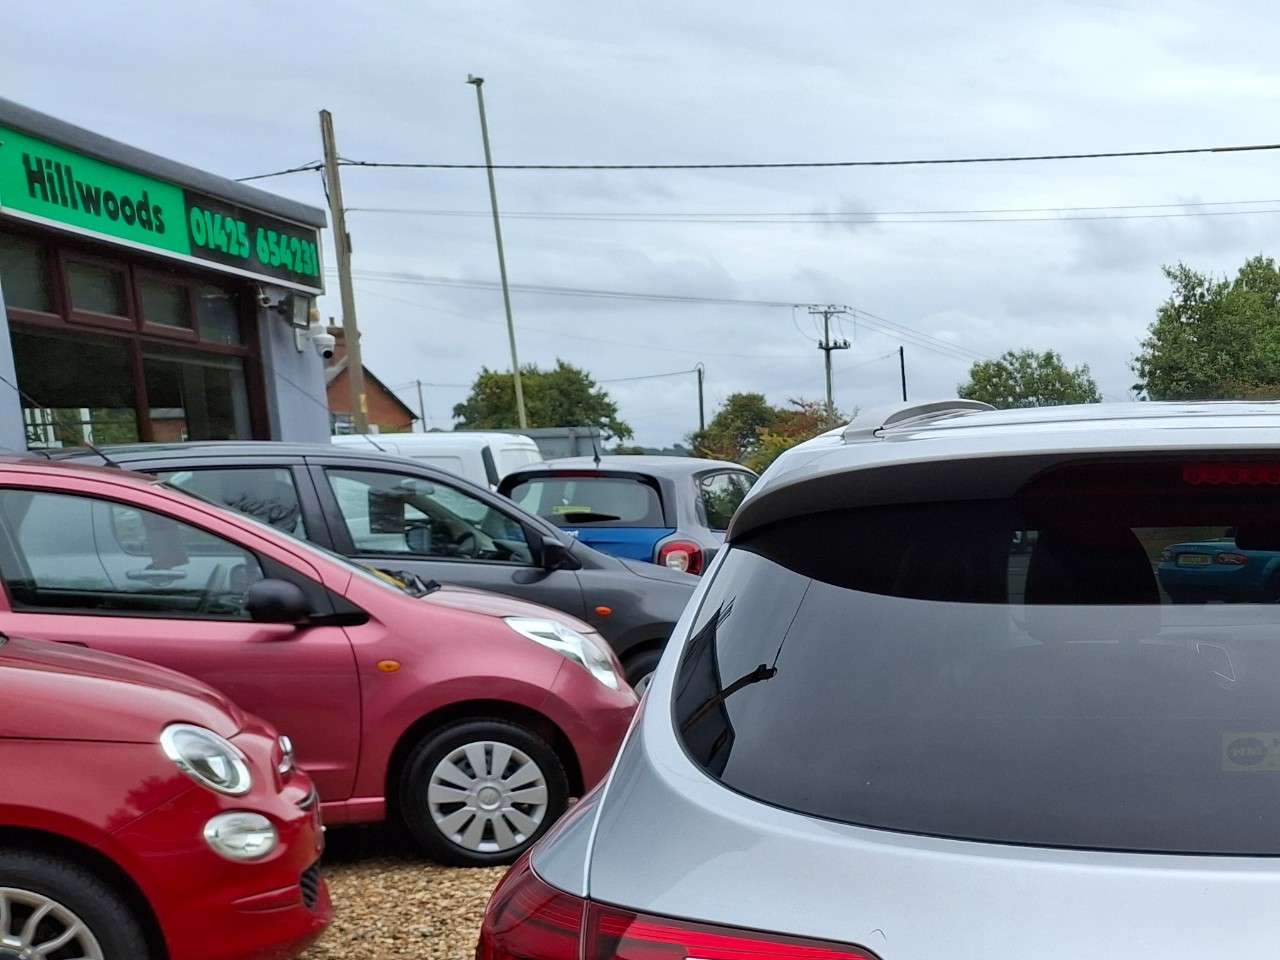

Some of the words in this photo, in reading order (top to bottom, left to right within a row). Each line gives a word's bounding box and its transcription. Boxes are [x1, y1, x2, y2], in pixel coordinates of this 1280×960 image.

[22, 152, 165, 235] Hillwoods
[190, 206, 250, 260] 01425
[256, 227, 320, 278] 654231
